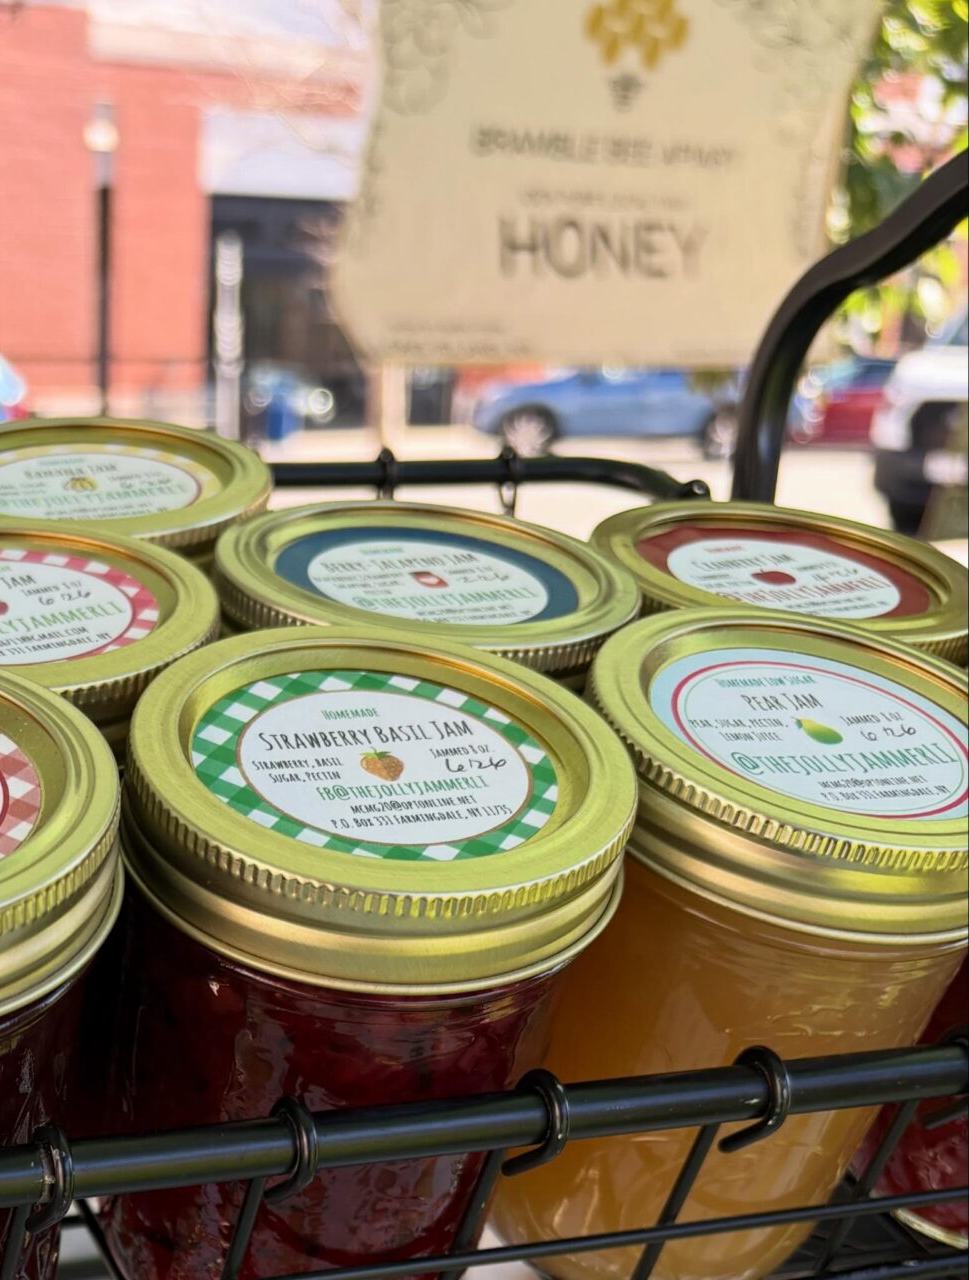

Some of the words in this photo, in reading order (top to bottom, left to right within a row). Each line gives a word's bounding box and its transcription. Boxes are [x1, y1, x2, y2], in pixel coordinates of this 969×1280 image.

[497, 214, 710, 281] HONEY
[0, 574, 38, 589] JAM
[740, 694, 788, 711] PEAR
[780, 693, 824, 711] JAM
[322, 708, 379, 720] HOMEMADE
[258, 728, 374, 751] STRAWBERRY
[373, 724, 432, 744] BASIL
[430, 720, 473, 740] JAM
[430, 746, 469, 759] JAMMED
[731, 743, 959, 776] @THEJOLLYJAMMERLI
[252, 759, 316, 771] STRAWBERRY,
[268, 774, 306, 783] SUGAR,
[306, 771, 341, 782] PECTIN
[316, 775, 490, 801] FB@THEJOLLYJAMMERLI
[353, 818, 374, 827] BOX
[377, 815, 394, 826] 331
[394, 810, 468, 825] FARMINGDALE,
[467, 808, 480, 819] NY
